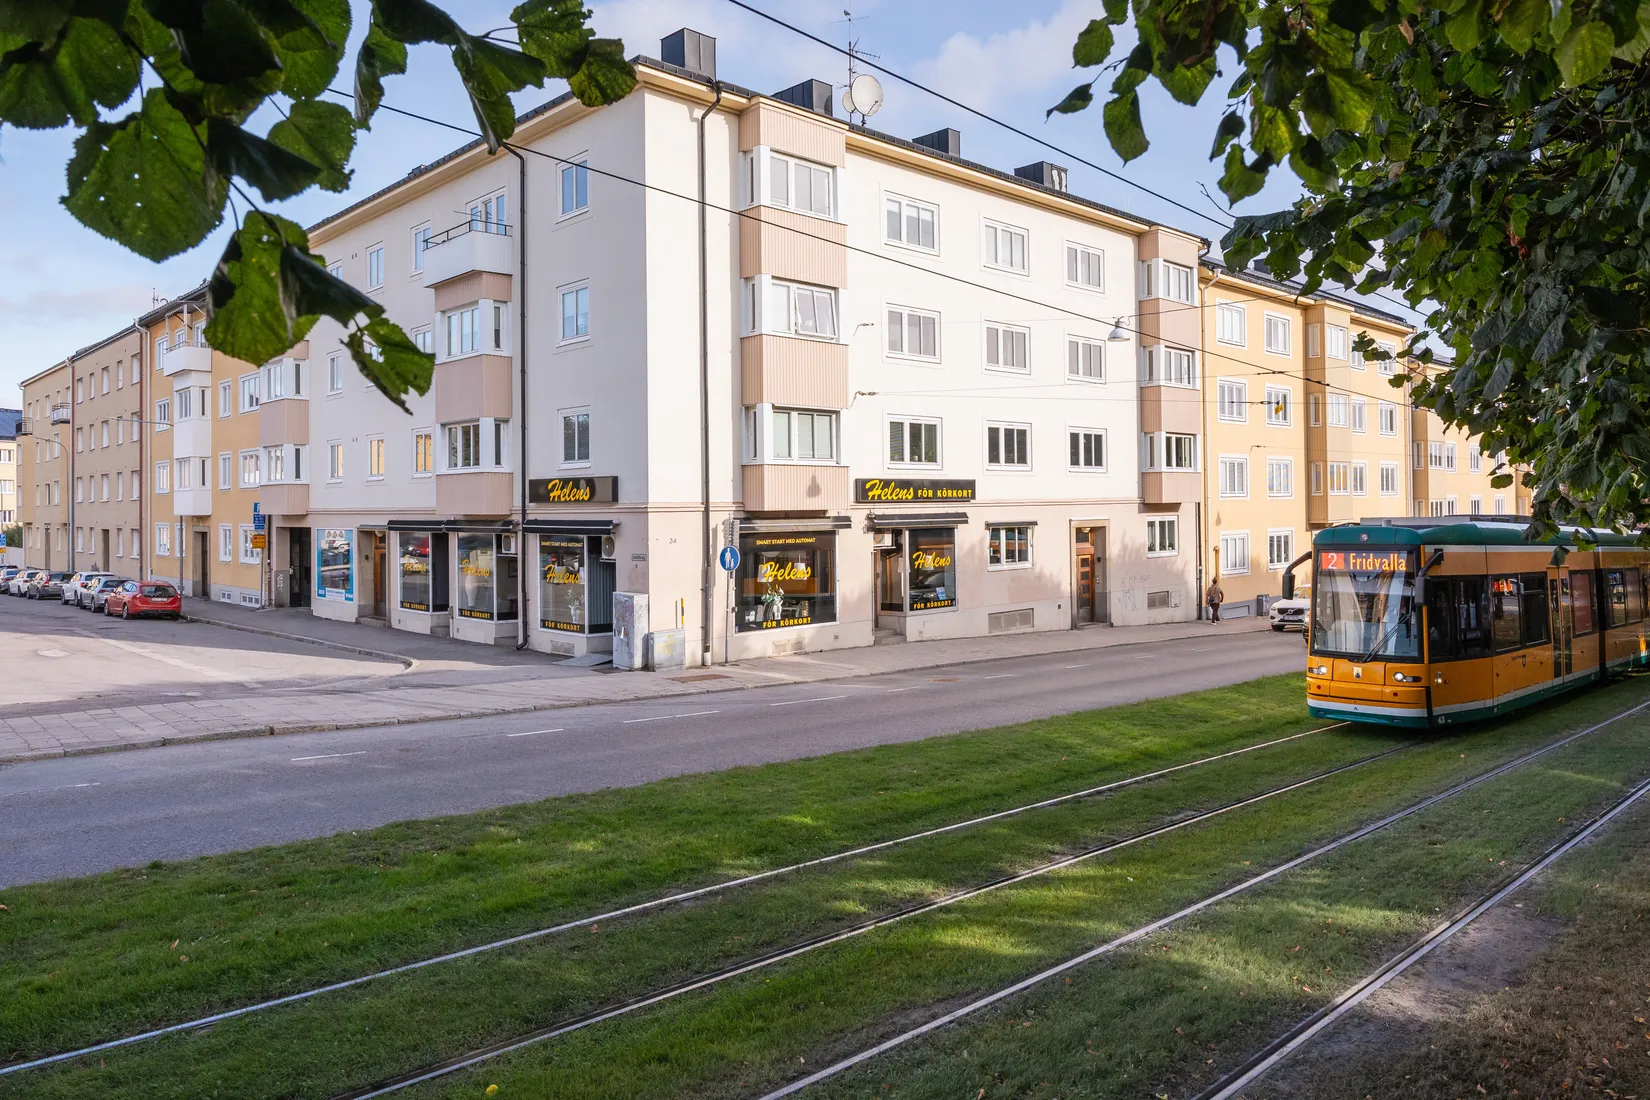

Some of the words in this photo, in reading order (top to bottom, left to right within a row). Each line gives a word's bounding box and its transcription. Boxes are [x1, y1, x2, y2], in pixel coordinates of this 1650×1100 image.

[548, 479, 590, 502] Helens
[865, 479, 914, 500] Helens
[918, 488, 933, 498] FÖR
[937, 488, 972, 498] KÖRKORT
[913, 551, 951, 569] Helens
[1328, 553, 1337, 569] 2
[1349, 553, 1406, 571] Fridvalla
[545, 563, 580, 584] Helens
[762, 561, 811, 581] Helens
[914, 601, 924, 610] FÖR
[927, 600, 951, 608] KÖRKORT
[763, 620, 777, 628] FÖR
[780, 617, 811, 626] KÖRKORT
